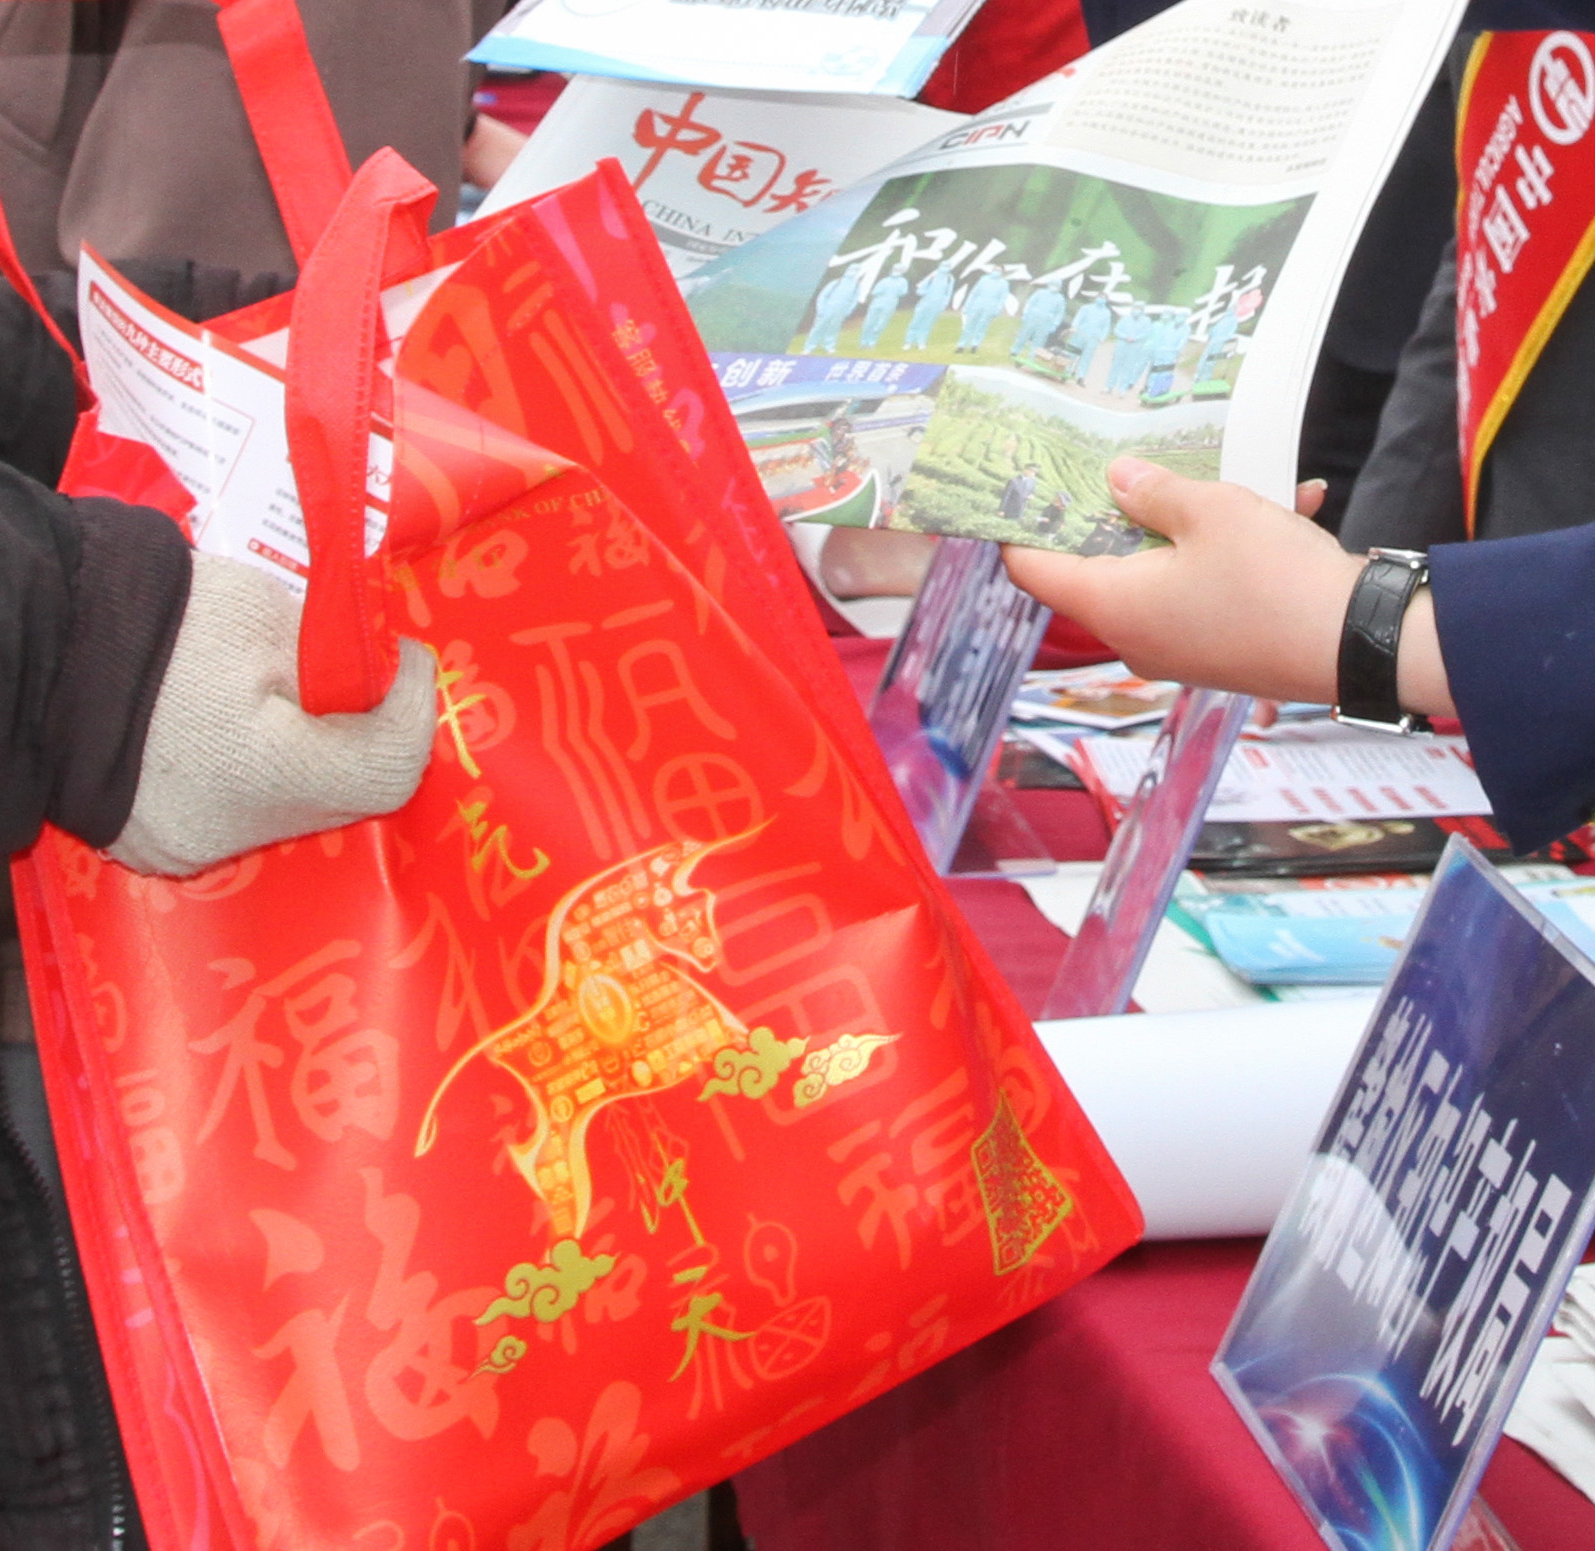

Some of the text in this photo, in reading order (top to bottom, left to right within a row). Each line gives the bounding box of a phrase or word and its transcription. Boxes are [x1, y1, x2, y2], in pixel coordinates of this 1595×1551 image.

[940, 119, 1031, 149] CIPN
[641, 199, 713, 237] CHINA
[711, 357, 798, 388] 创新
